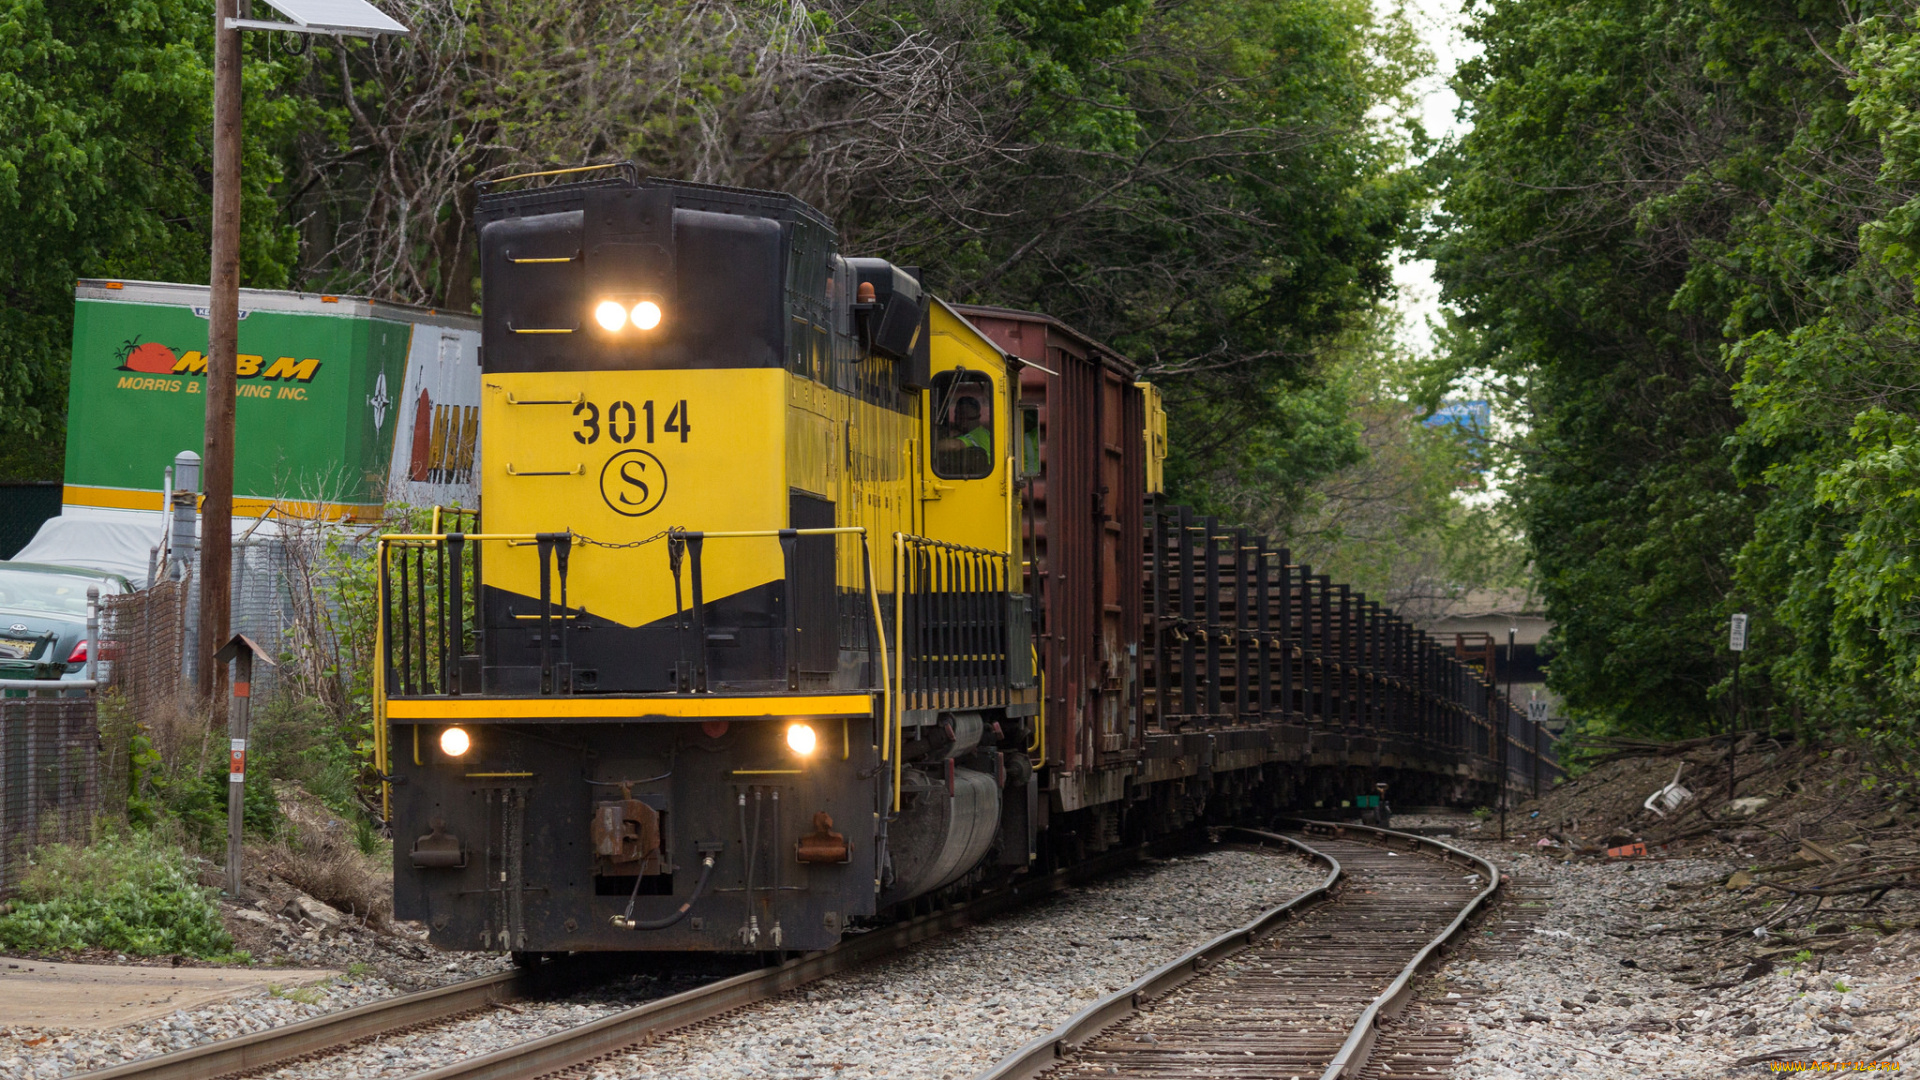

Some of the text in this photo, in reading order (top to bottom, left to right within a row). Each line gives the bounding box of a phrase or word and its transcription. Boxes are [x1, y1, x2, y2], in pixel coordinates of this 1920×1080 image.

[117, 377, 182, 392] MORRIS
[186, 381, 201, 393] B.
[277, 387, 308, 400] INC.
[573, 400, 691, 445] 3014
[619, 460, 649, 506] S
[1529, 703, 1546, 718] W
